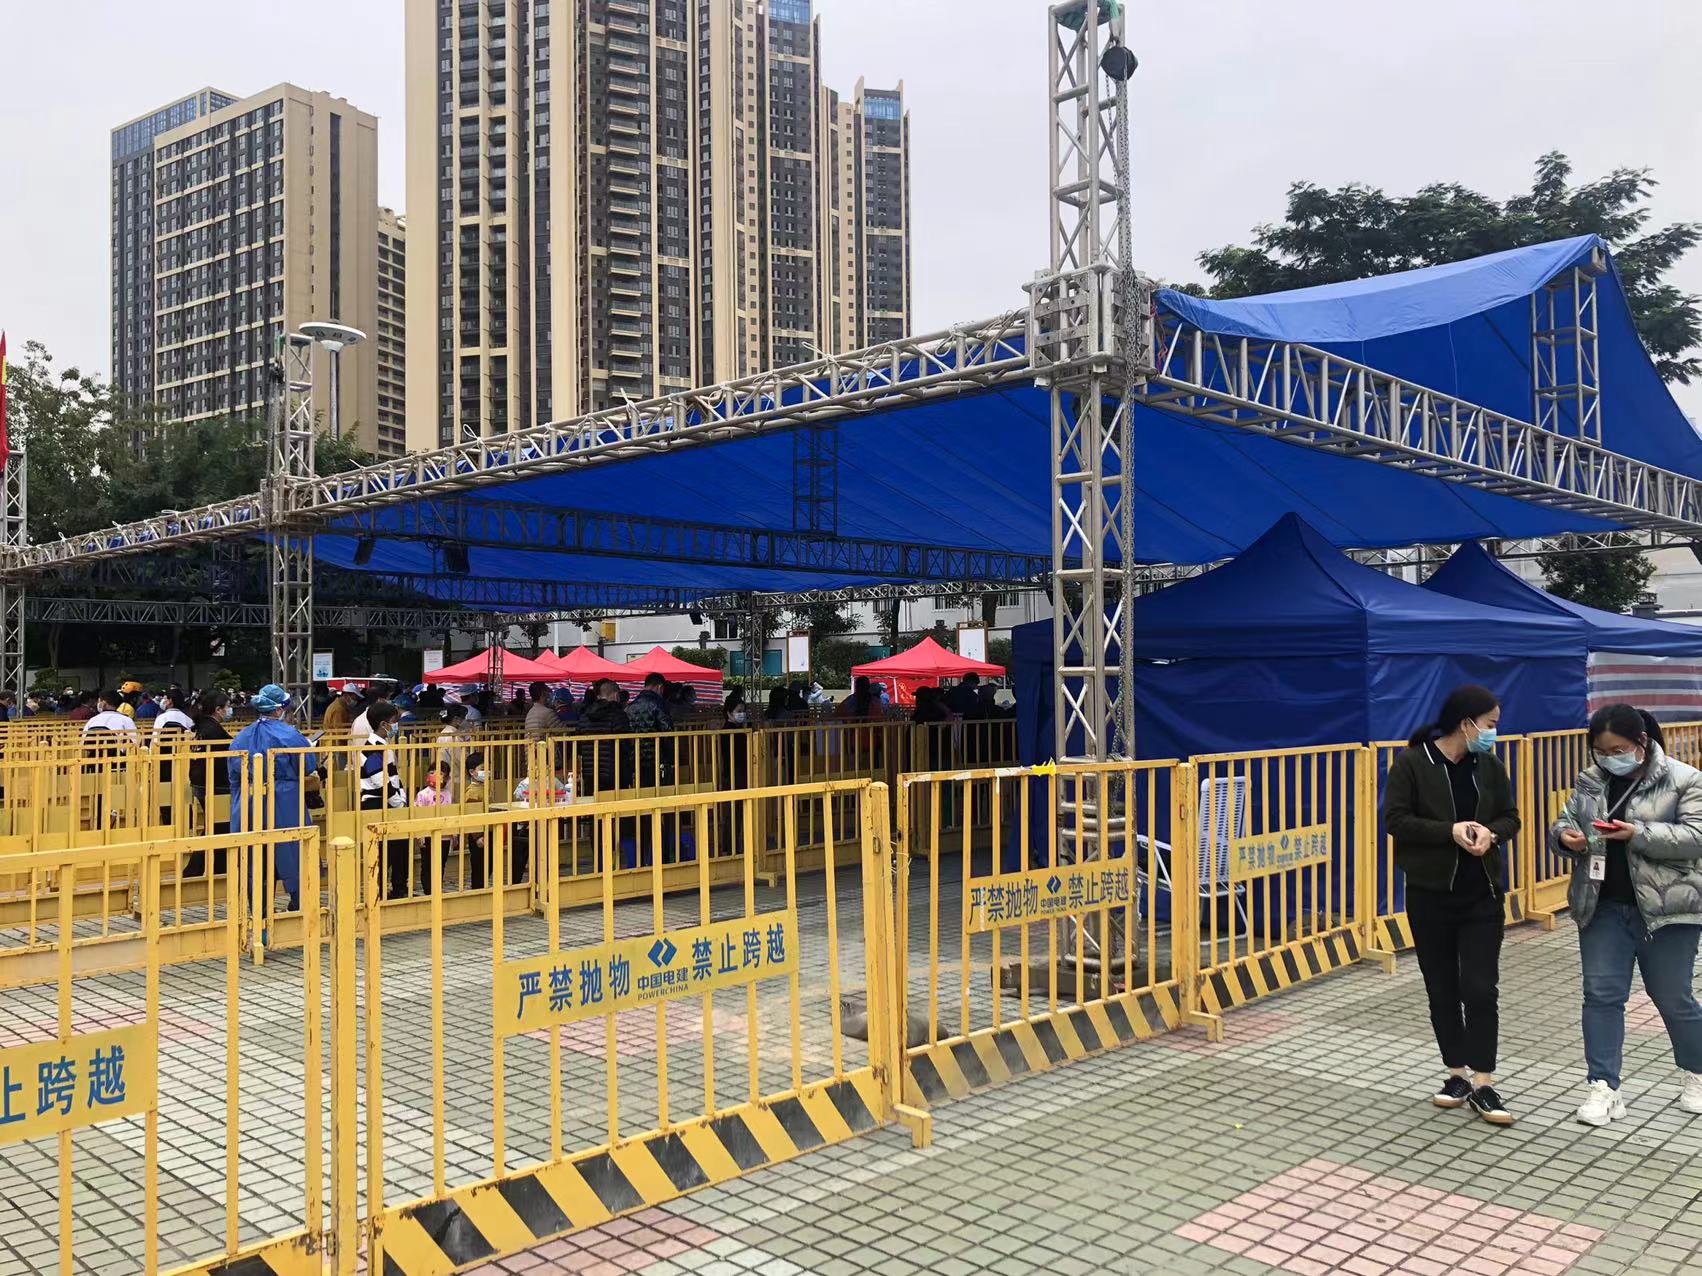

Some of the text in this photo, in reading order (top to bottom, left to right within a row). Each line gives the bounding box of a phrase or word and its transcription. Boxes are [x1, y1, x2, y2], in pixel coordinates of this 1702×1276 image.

[968, 867, 1129, 926] 严禁抛物 禁止跨越
[516, 922, 786, 1020] 严禁抛物 禁止跨越
[637, 967, 689, 991] 中国电建
[637, 983, 689, 1001] POWERCHINA
